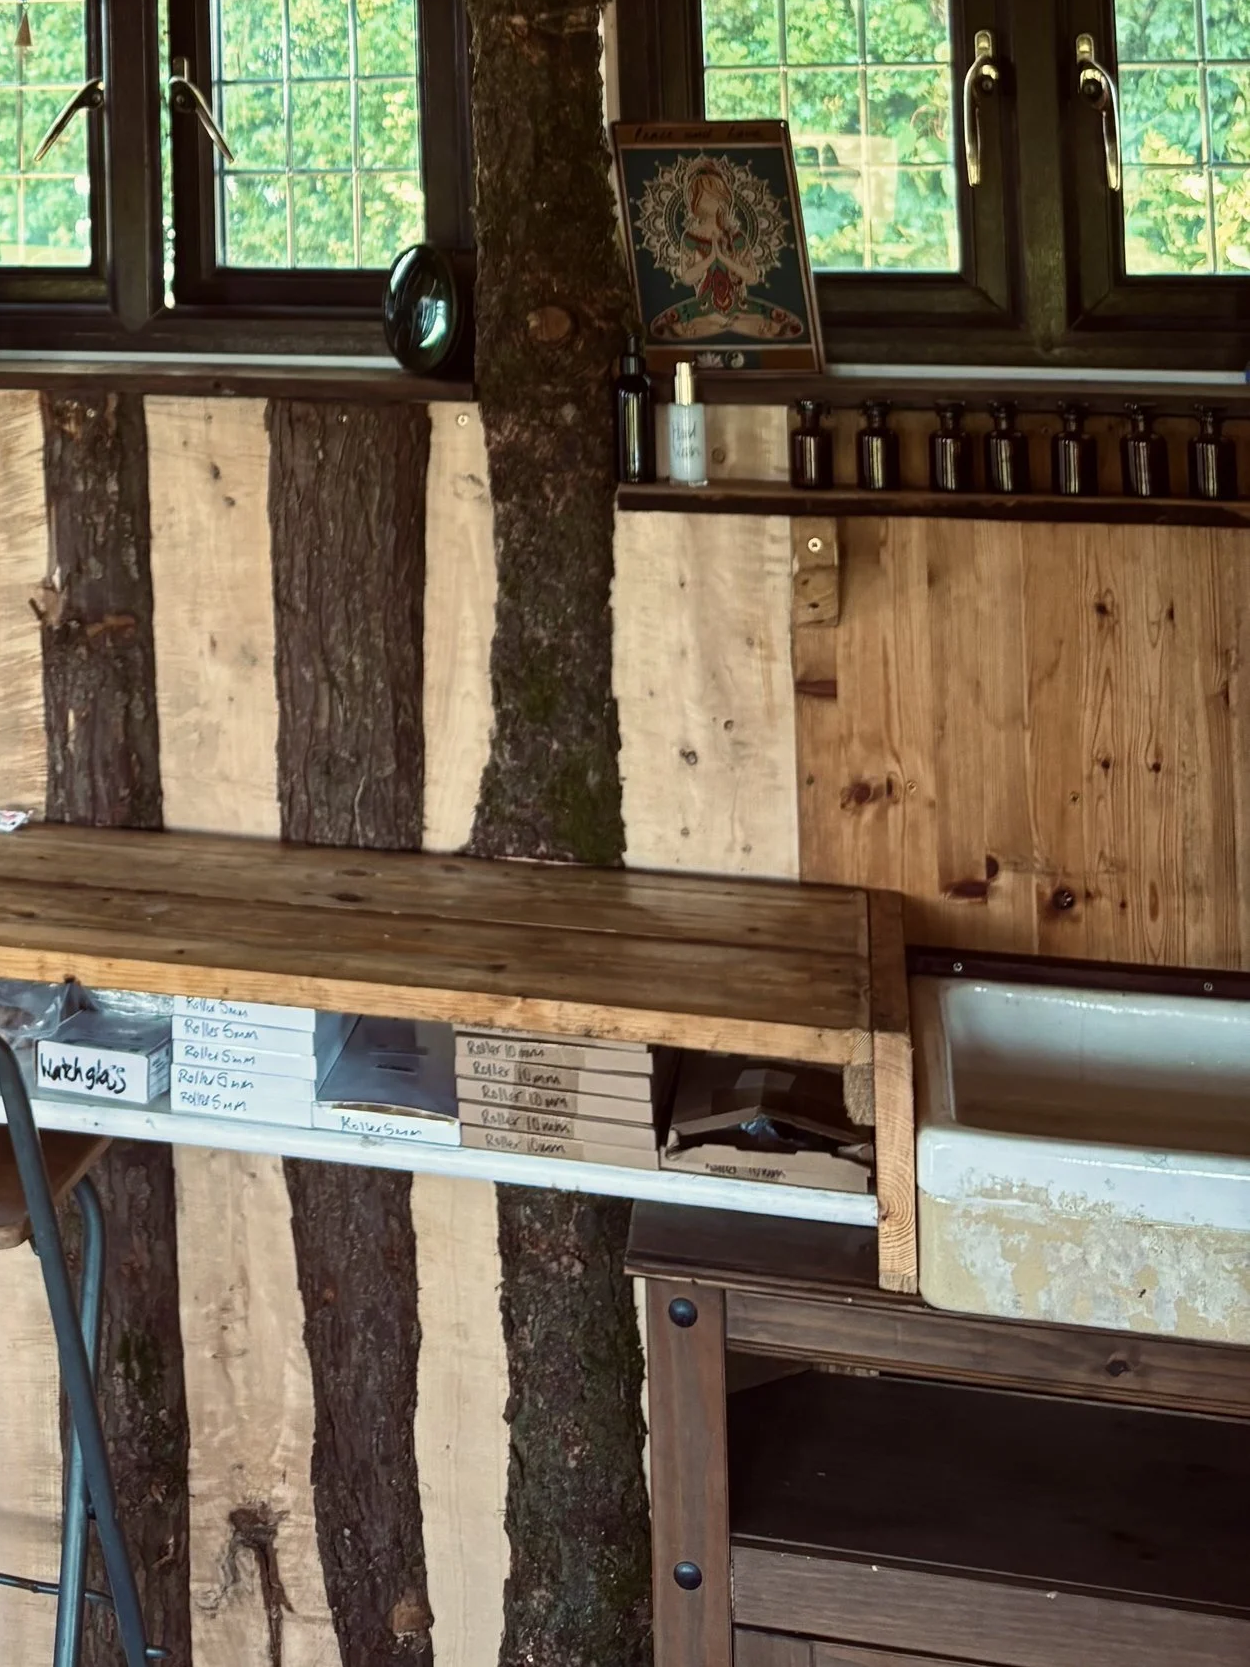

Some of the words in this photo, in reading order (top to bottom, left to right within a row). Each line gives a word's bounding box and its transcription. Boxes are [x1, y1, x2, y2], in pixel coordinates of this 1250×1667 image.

[186, 996, 216, 1013] Roller
[184, 1018, 220, 1037] Roller
[184, 1045, 218, 1061] Roller
[466, 1040, 501, 1054] Roller
[178, 1068, 216, 1085] Roller
[473, 1060, 510, 1078] Roller
[180, 1090, 210, 1106] Roller
[481, 1084, 523, 1103] Roller
[341, 1115, 382, 1134] Roller
[481, 1108, 520, 1126] Roller
[485, 1133, 521, 1149] Roller
